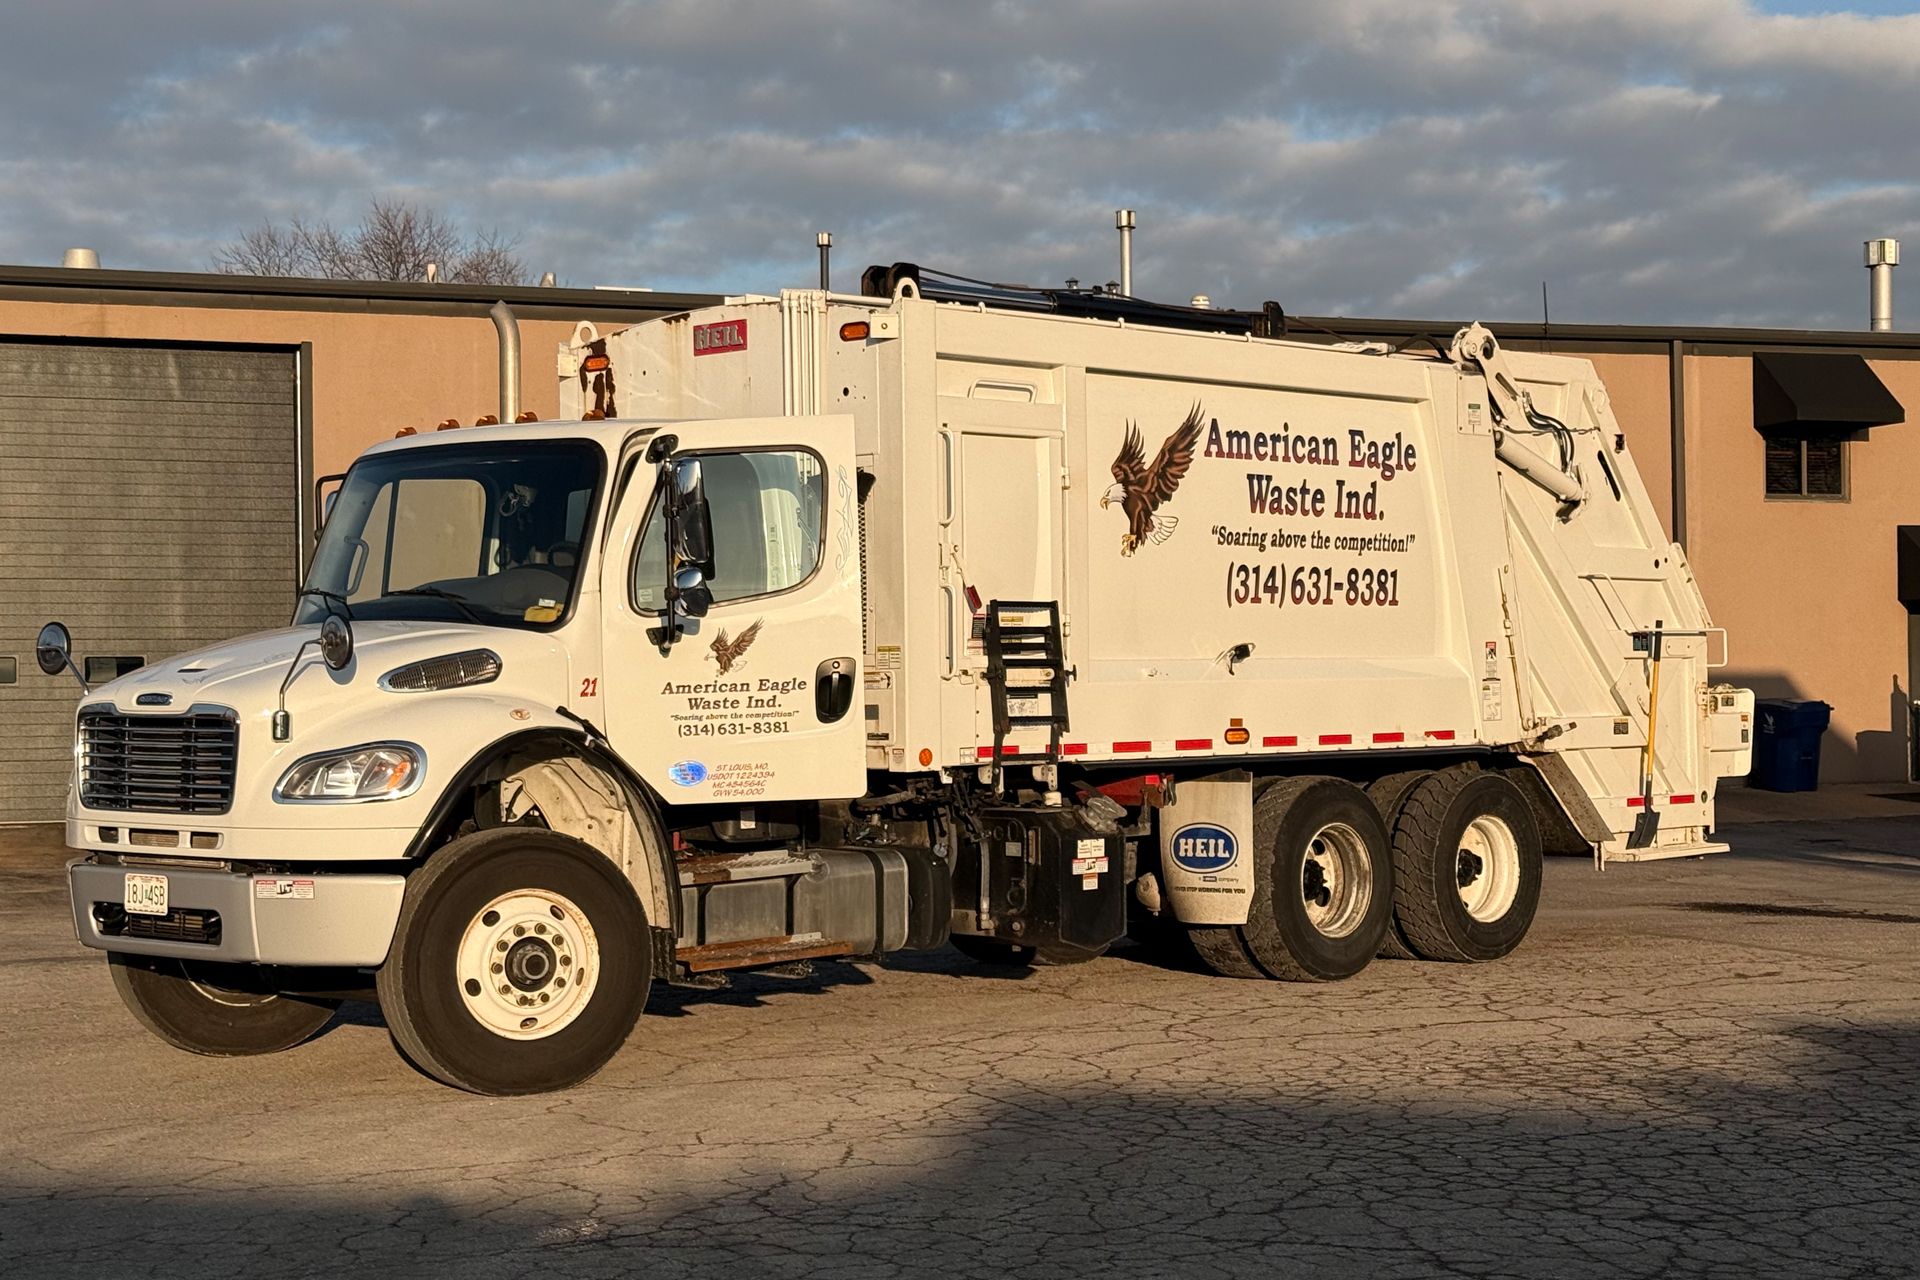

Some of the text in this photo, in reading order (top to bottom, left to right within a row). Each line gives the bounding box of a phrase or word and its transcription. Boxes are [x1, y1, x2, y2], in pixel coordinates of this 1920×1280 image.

[694, 325, 743, 350] HEIL
[1204, 418, 1417, 481] American Eagle
[1246, 473, 1385, 521] Waste Ind.
[1211, 525, 1415, 556] “Soaring above the competition!”
[1226, 561, 1399, 609] (314)631-8381
[580, 677, 598, 697] 21
[661, 677, 807, 695] American Eagle
[687, 695, 782, 711] Waste Ind.
[706, 772, 734, 780] USDOT
[713, 789, 733, 797] GVW
[1178, 838, 1230, 858] HEIL
